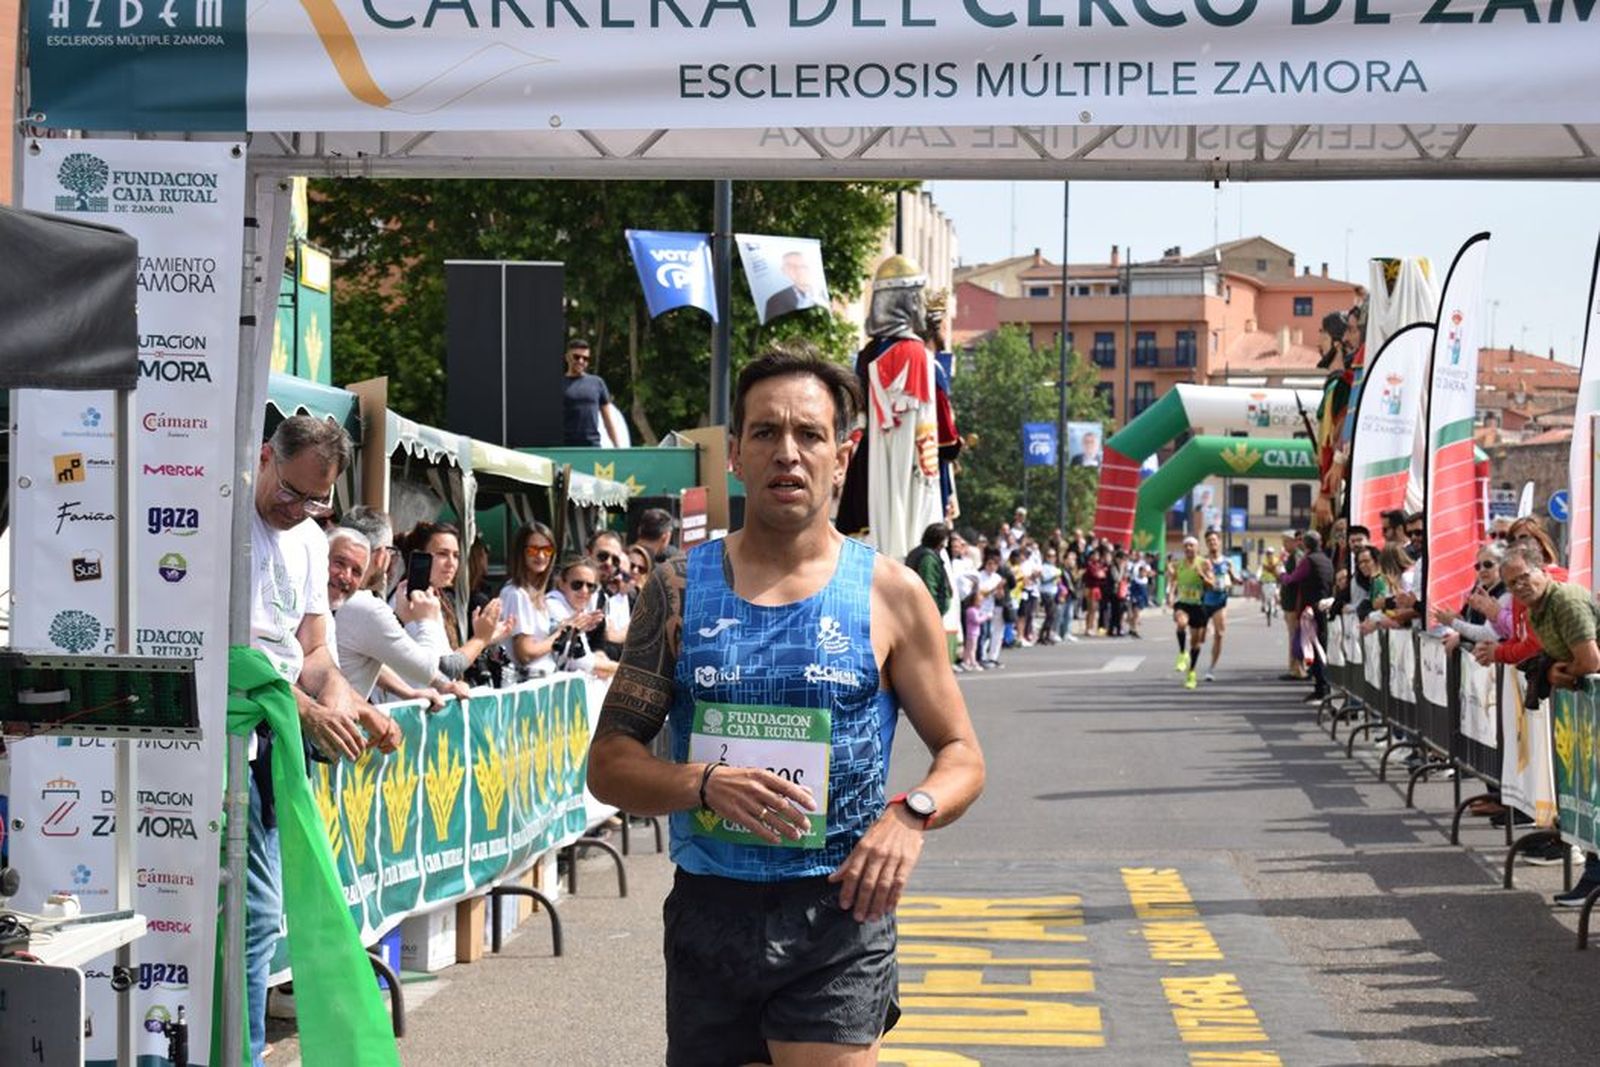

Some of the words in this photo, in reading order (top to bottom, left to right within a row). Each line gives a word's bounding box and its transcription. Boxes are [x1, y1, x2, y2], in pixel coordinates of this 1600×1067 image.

[47, 35, 114, 46] ESCLEROSIS
[116, 33, 170, 45] MÚLTIPLE
[173, 35, 224, 45] ZAMORA
[679, 62, 958, 98] ESCLEROSIS
[976, 54, 1197, 97] MÚLTIPLE
[1213, 60, 1428, 94] ZAMORA
[112, 171, 218, 187] FUNDACION
[112, 187, 154, 202] CAJA
[160, 187, 218, 203] RURAL
[113, 205, 128, 213] DE
[131, 205, 174, 214] ZAMORA
[138, 257, 216, 274] TAMIENTO
[137, 274, 216, 293] AMORA
[138, 335, 207, 350] UTACION
[138, 361, 212, 382] MORA
[143, 412, 208, 432] Cámara
[1263, 449, 1313, 467] CAJA
[148, 506, 199, 535] gaza
[727, 725, 759, 737] CAJA
[764, 726, 811, 739] RURAL
[720, 743, 728, 761] 2
[139, 962, 189, 991] gaza
